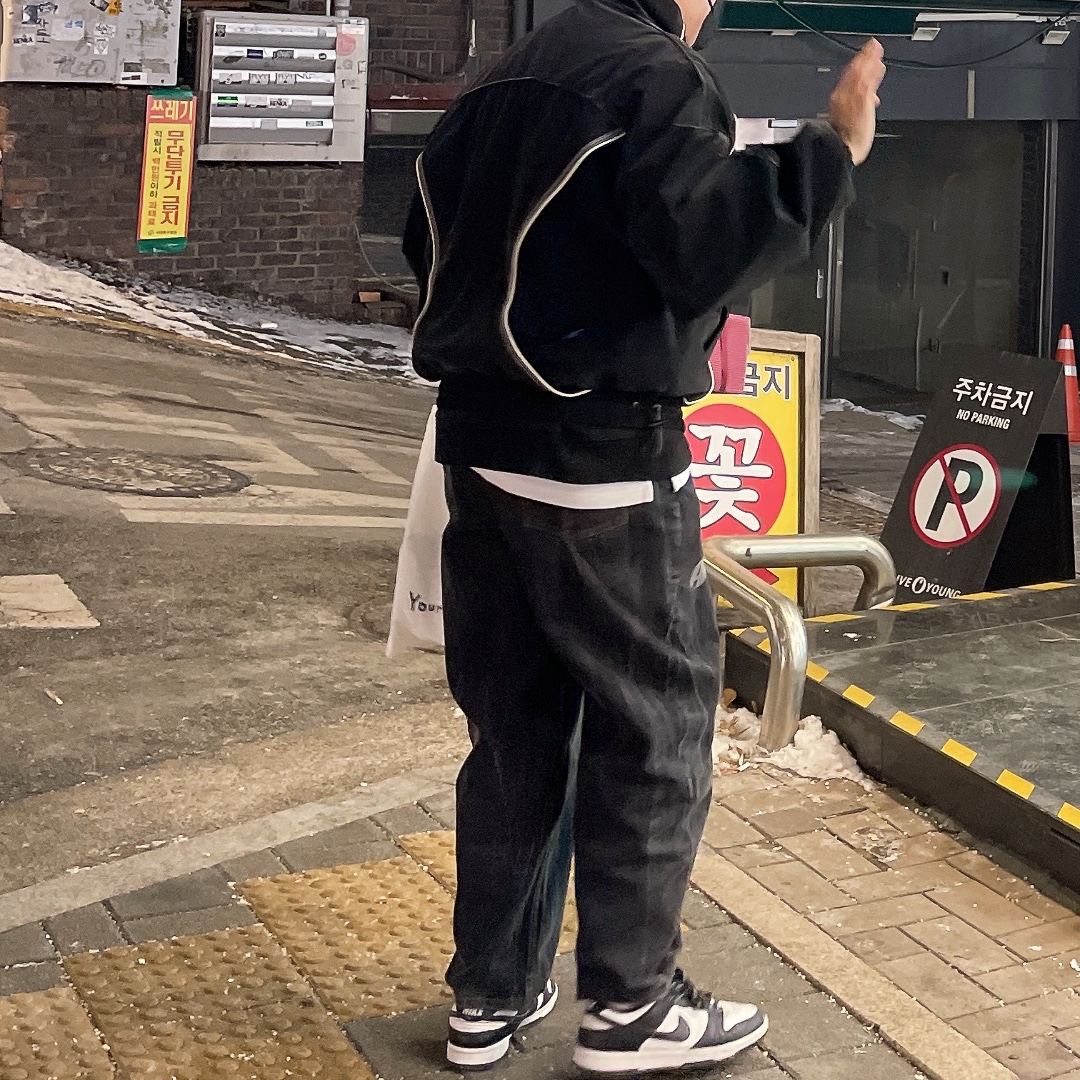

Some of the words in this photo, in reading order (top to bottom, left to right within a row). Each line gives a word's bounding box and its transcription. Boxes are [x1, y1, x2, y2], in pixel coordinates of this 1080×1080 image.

[150, 99, 193, 120] 쓰레기
[163, 130, 184, 191] 무단투기
[160, 195, 180, 225] 금지
[952, 377, 1034, 416] 주차금지
[956, 408, 970, 421] NO
[970, 411, 1011, 430] PARKING
[689, 423, 774, 532] 꽃
